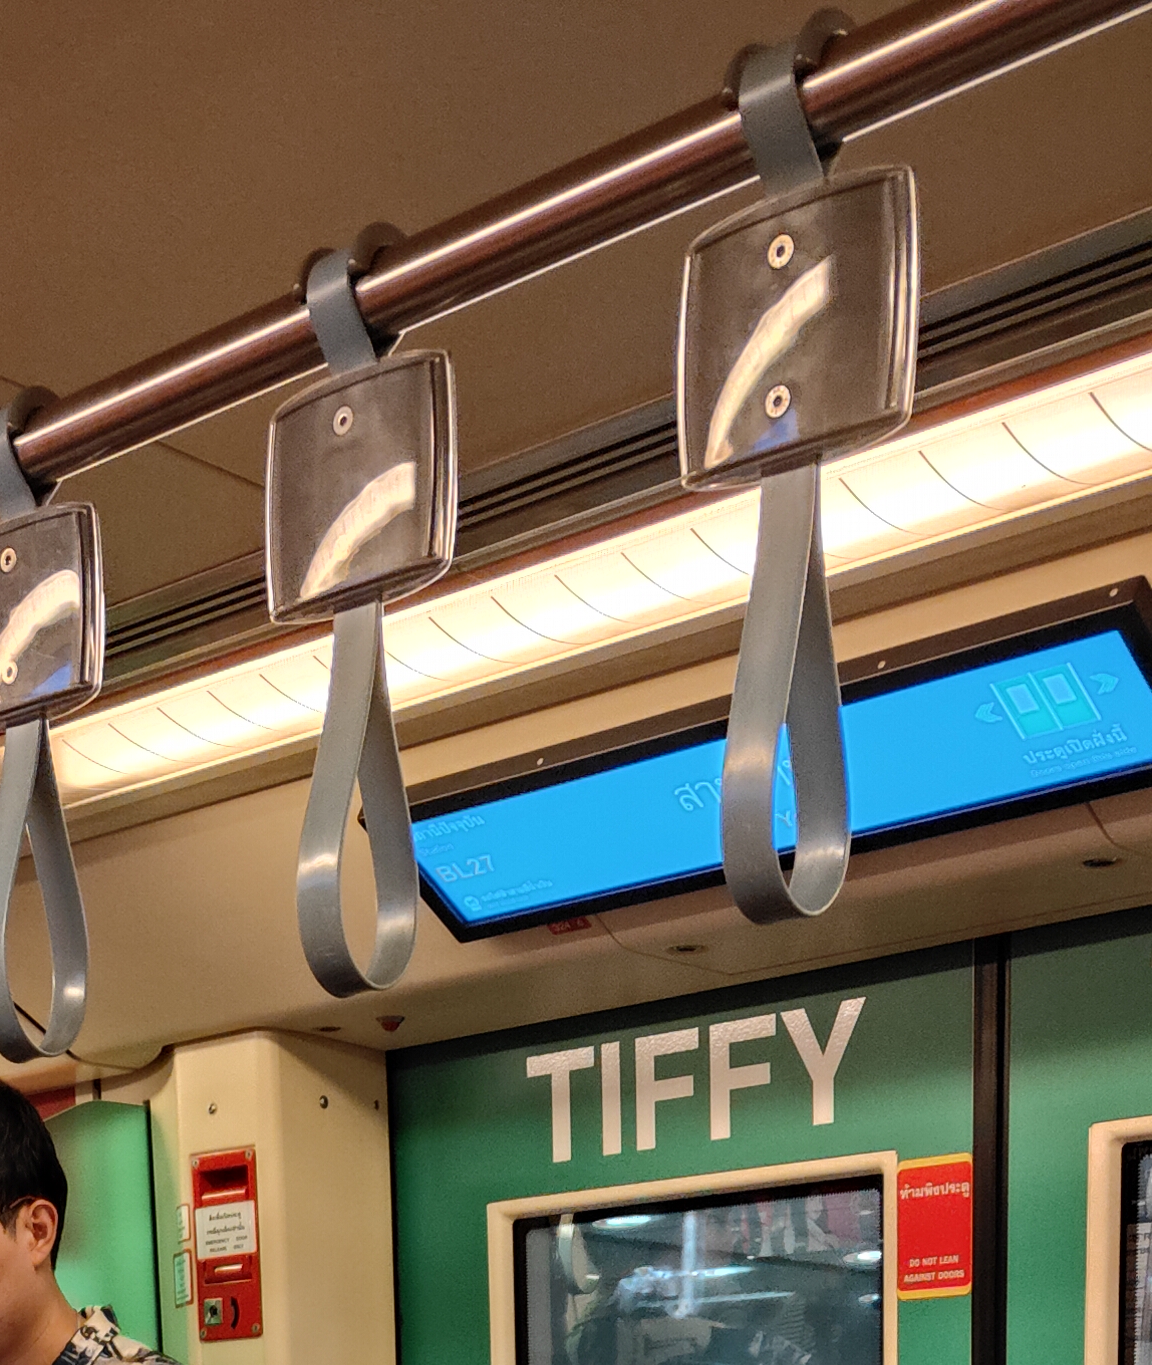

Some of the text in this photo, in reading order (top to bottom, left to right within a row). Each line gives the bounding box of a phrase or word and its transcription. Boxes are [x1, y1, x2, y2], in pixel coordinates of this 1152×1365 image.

[1023, 723, 1128, 764] ประตูเปิดฝั่งนี้
[435, 854, 495, 883] BL27
[526, 996, 867, 1163] TIFFY
[900, 1181, 970, 1199] ห้ามพิงประตู
[909, 1254, 959, 1268] DO NOT LEAN
[904, 1269, 965, 1283] AGAINST DOORS
